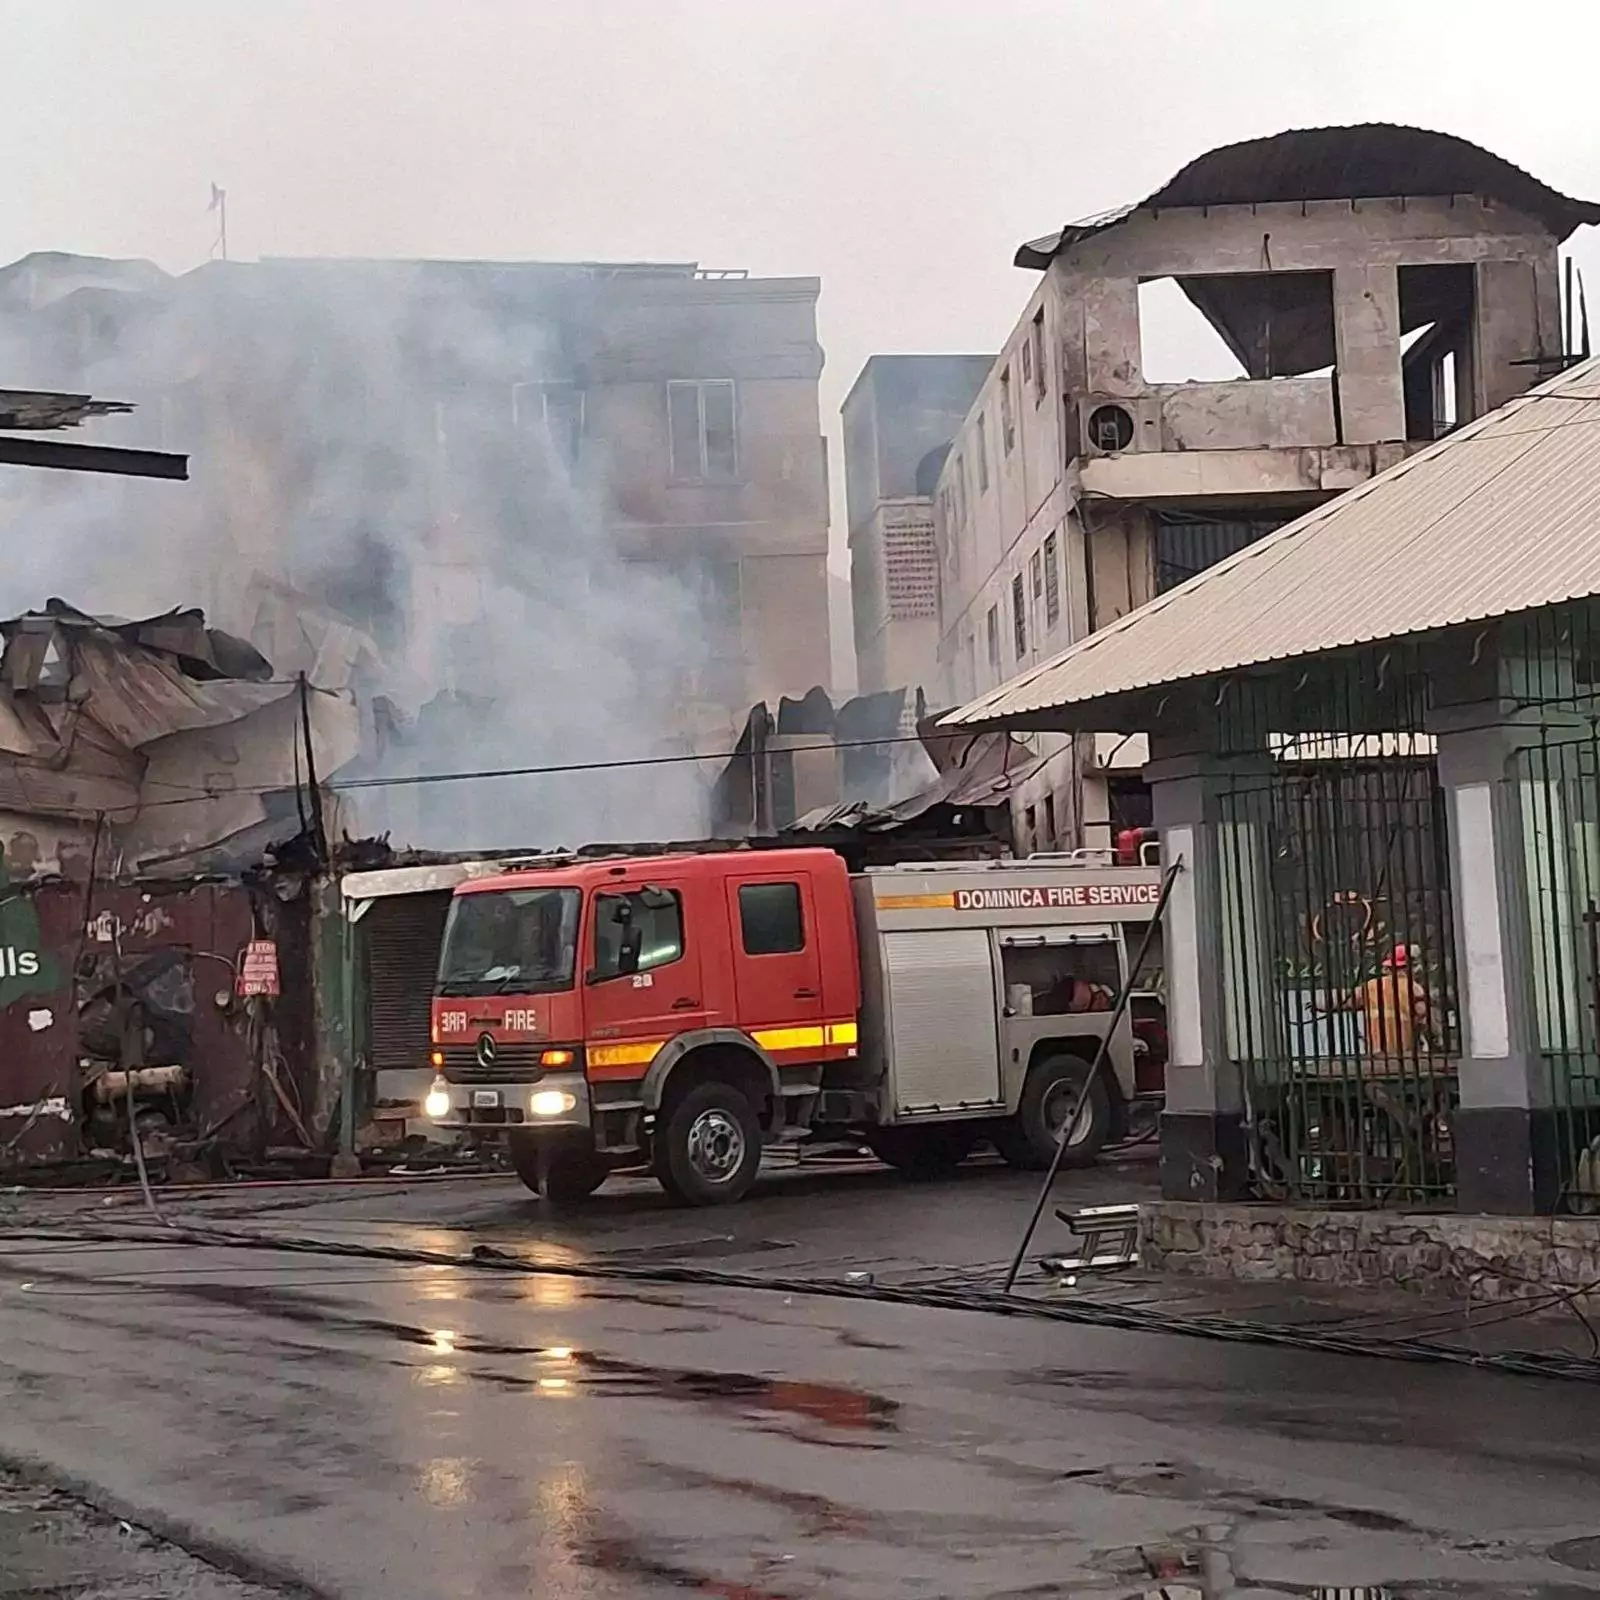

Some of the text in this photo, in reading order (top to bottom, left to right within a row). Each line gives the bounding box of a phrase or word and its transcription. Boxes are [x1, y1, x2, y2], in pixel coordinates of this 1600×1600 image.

[958, 885, 1160, 909] DOMINICA FIRE SERVICE
[505, 1010, 536, 1031] FIRE
